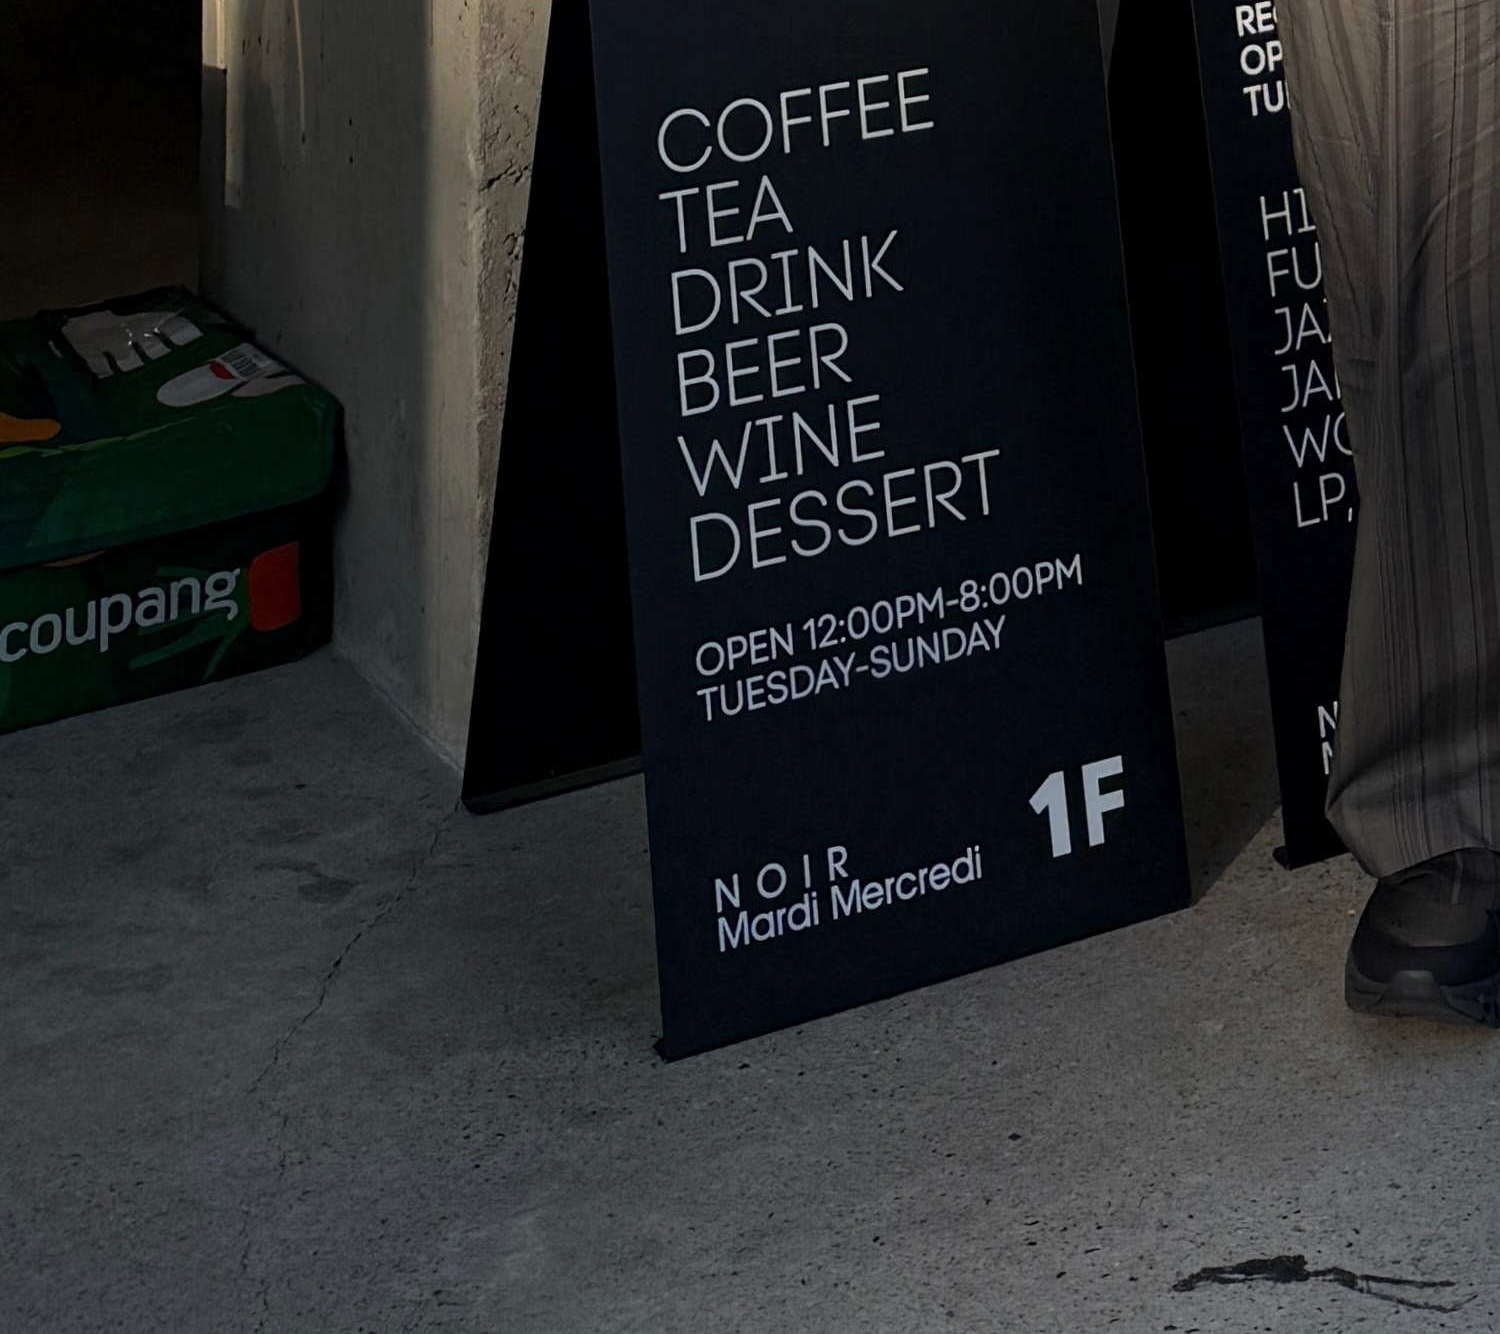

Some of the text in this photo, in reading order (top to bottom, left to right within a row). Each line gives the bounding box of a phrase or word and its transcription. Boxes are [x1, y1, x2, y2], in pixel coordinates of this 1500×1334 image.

[1235, 1, 1279, 37] RE
[657, 67, 935, 173] COFFEE
[1242, 80, 1291, 116] TU
[658, 174, 794, 254] TEA
[670, 229, 904, 336] DRINK
[1274, 298, 1333, 355] JA
[676, 322, 853, 417] BEER
[1281, 359, 1342, 413] JA
[676, 394, 886, 497] WINE
[689, 448, 1000, 583] DESSERT
[0, 567, 241, 663] coupang
[694, 553, 1084, 677] OPEN 12:00PM-8:00PM
[696, 614, 1006, 722] TUESDAY-SUNDAY
[1028, 755, 1125, 858] 1F
[714, 845, 849, 914] NOIR
[717, 845, 984, 953] Mardi Mercredi
